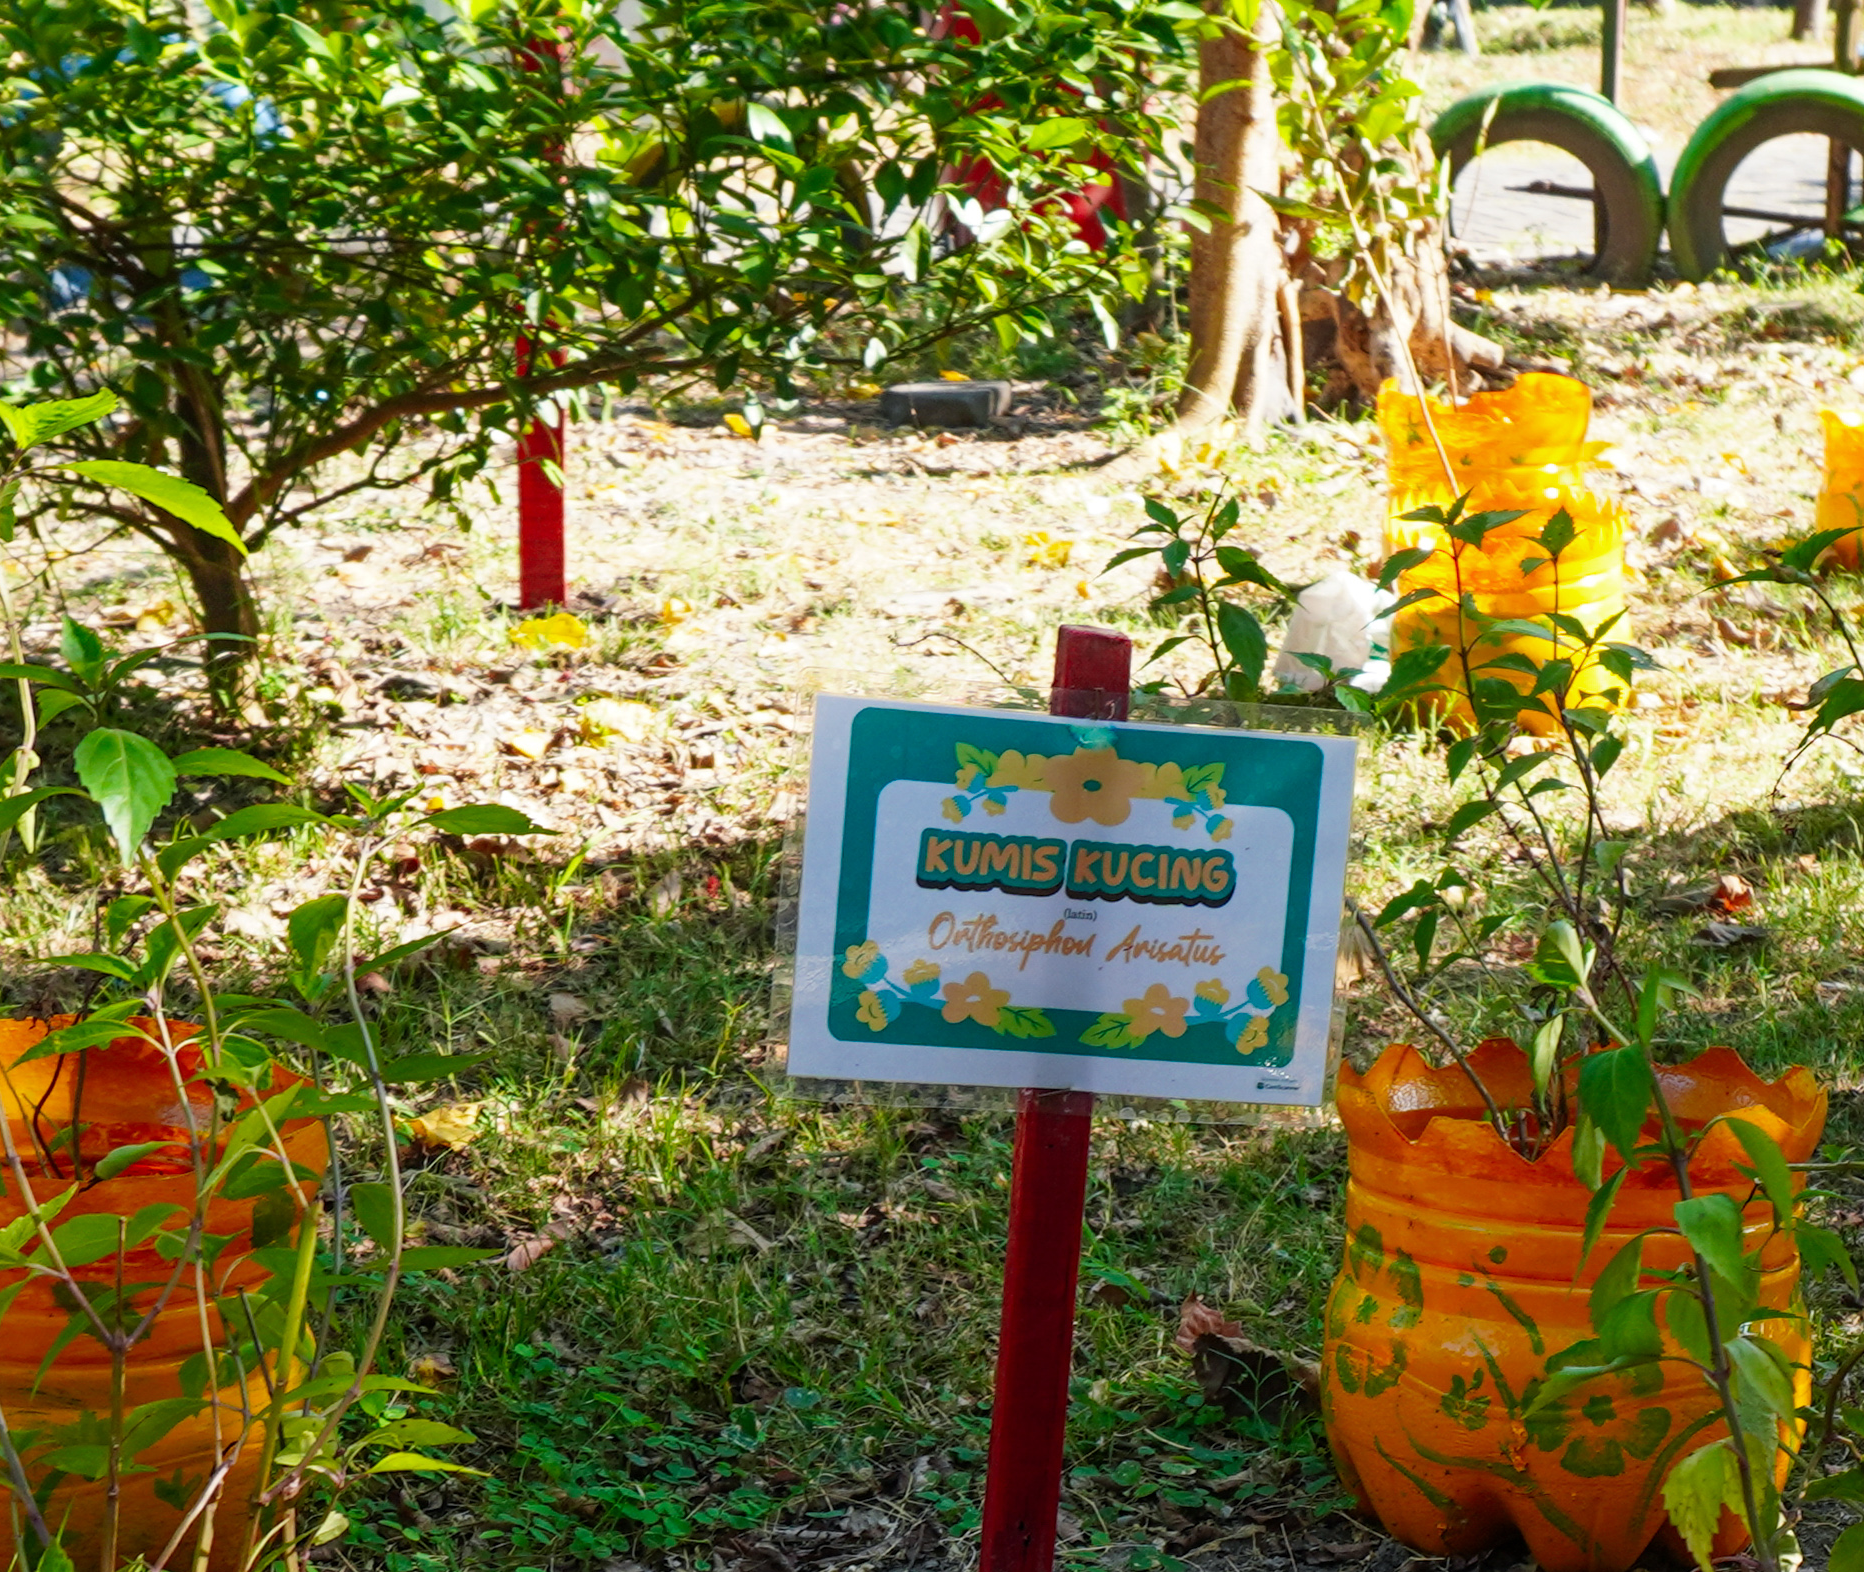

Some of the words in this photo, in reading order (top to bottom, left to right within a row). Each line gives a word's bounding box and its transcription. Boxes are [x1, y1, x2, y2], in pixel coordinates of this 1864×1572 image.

[923, 835, 1062, 883] KUMIS
[1072, 847, 1231, 893] KUCING
[927, 910, 1098, 972] Orthosiphon
[1063, 907, 1098, 922] (latin)
